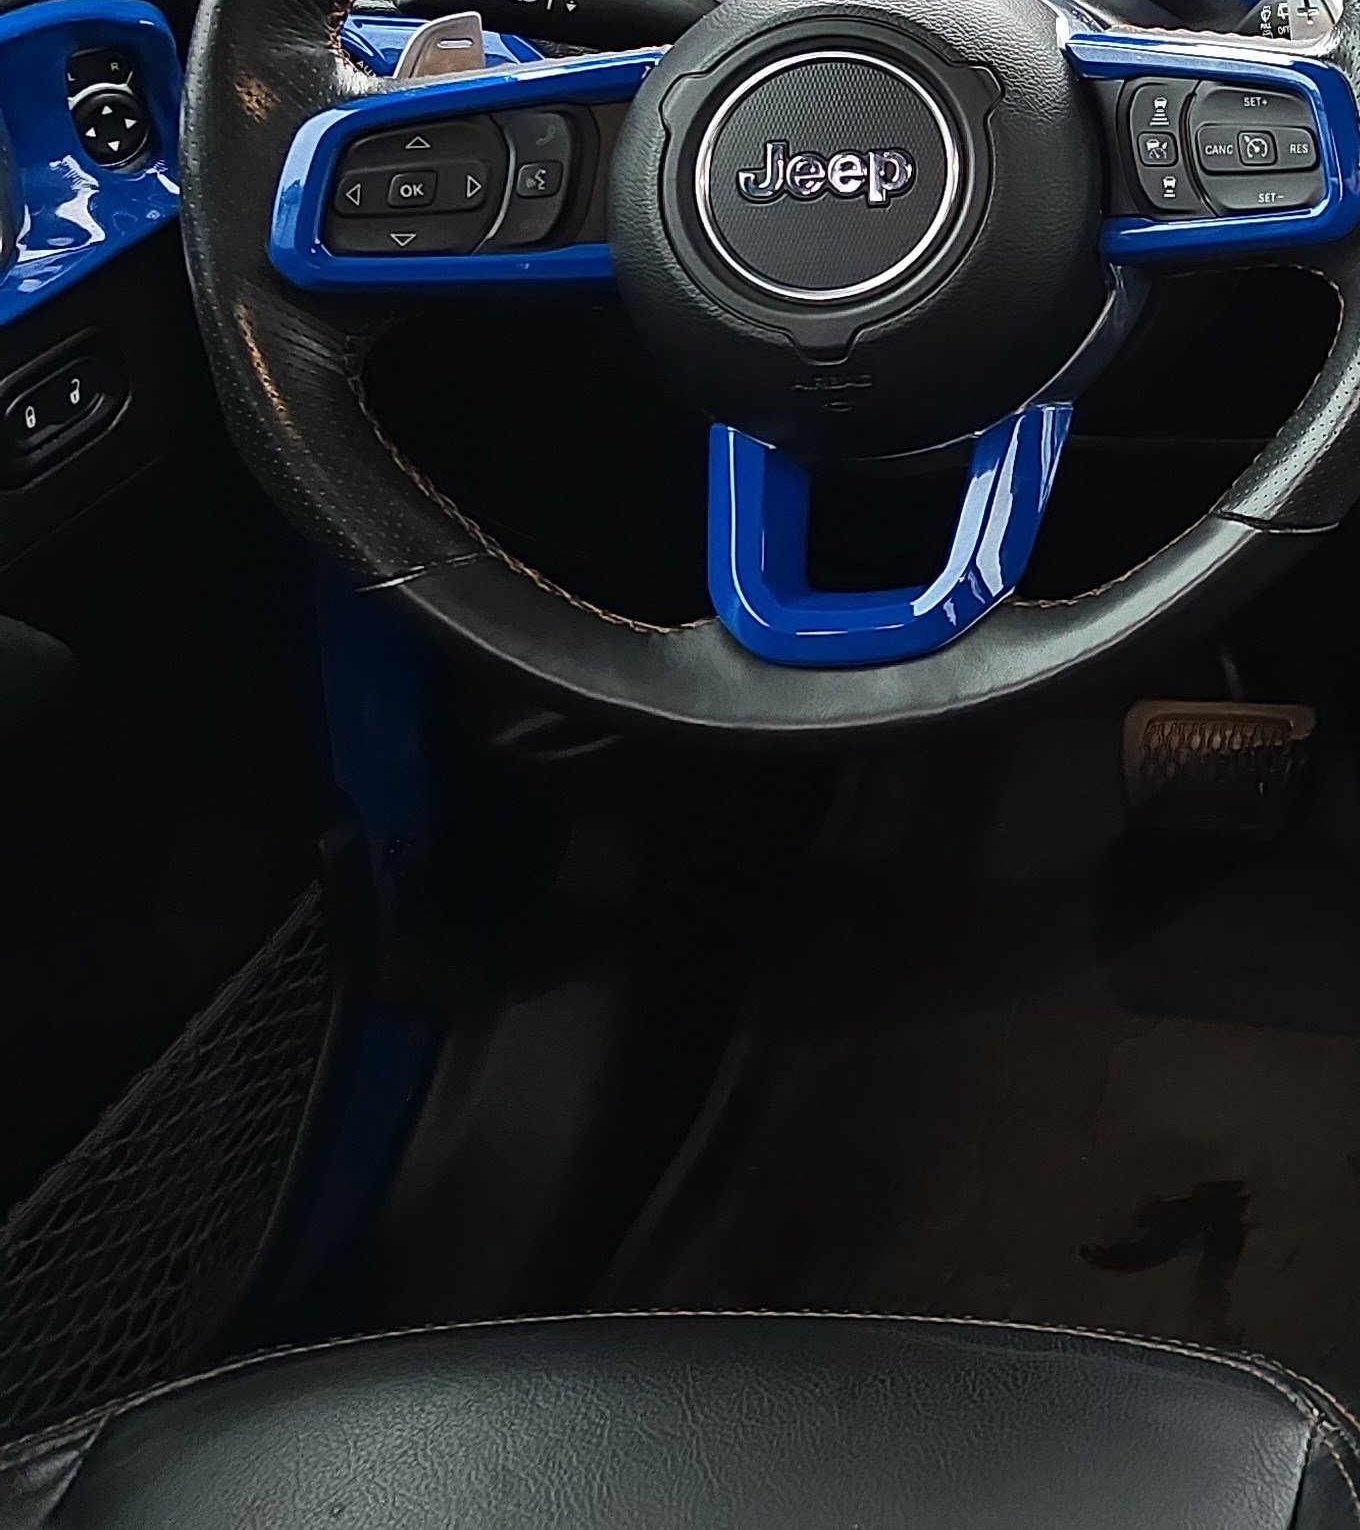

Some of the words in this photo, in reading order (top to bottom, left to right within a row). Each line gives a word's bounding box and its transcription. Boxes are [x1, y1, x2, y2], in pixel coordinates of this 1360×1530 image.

[110, 62, 120, 71] R
[67, 73, 76, 82] L
[1205, 145, 1233, 155] CANC
[1289, 144, 1308, 154] RES
[739, 142, 913, 203] Jeep
[400, 184, 424, 197] OK
